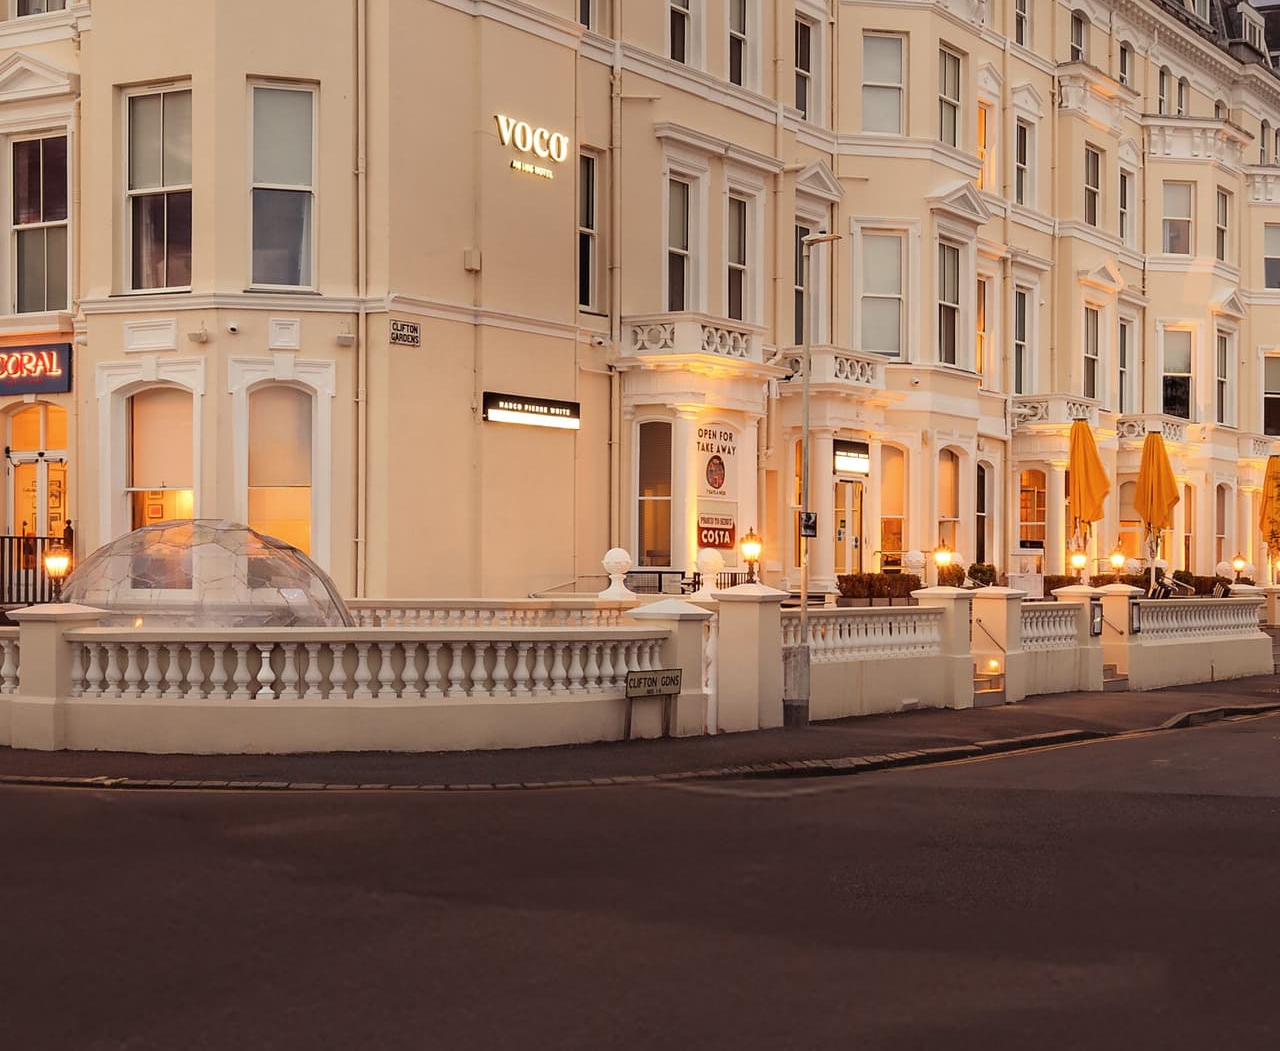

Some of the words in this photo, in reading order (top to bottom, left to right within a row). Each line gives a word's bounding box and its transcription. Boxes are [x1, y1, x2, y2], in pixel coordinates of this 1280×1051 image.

[391, 322, 419, 335] CLIFTON
[390, 332, 419, 344] GARDENS
[498, 401, 523, 411] MARCO
[524, 404, 548, 414] PIERRE
[550, 407, 570, 416] WHITE
[697, 428, 717, 440] OPEN
[719, 431, 734, 442] FOR
[696, 441, 714, 453] TAKE
[716, 444, 737, 456] AWAY
[701, 529, 731, 545] COSTA
[629, 676, 658, 689] CLIFTON
[661, 674, 680, 687] GDNS
